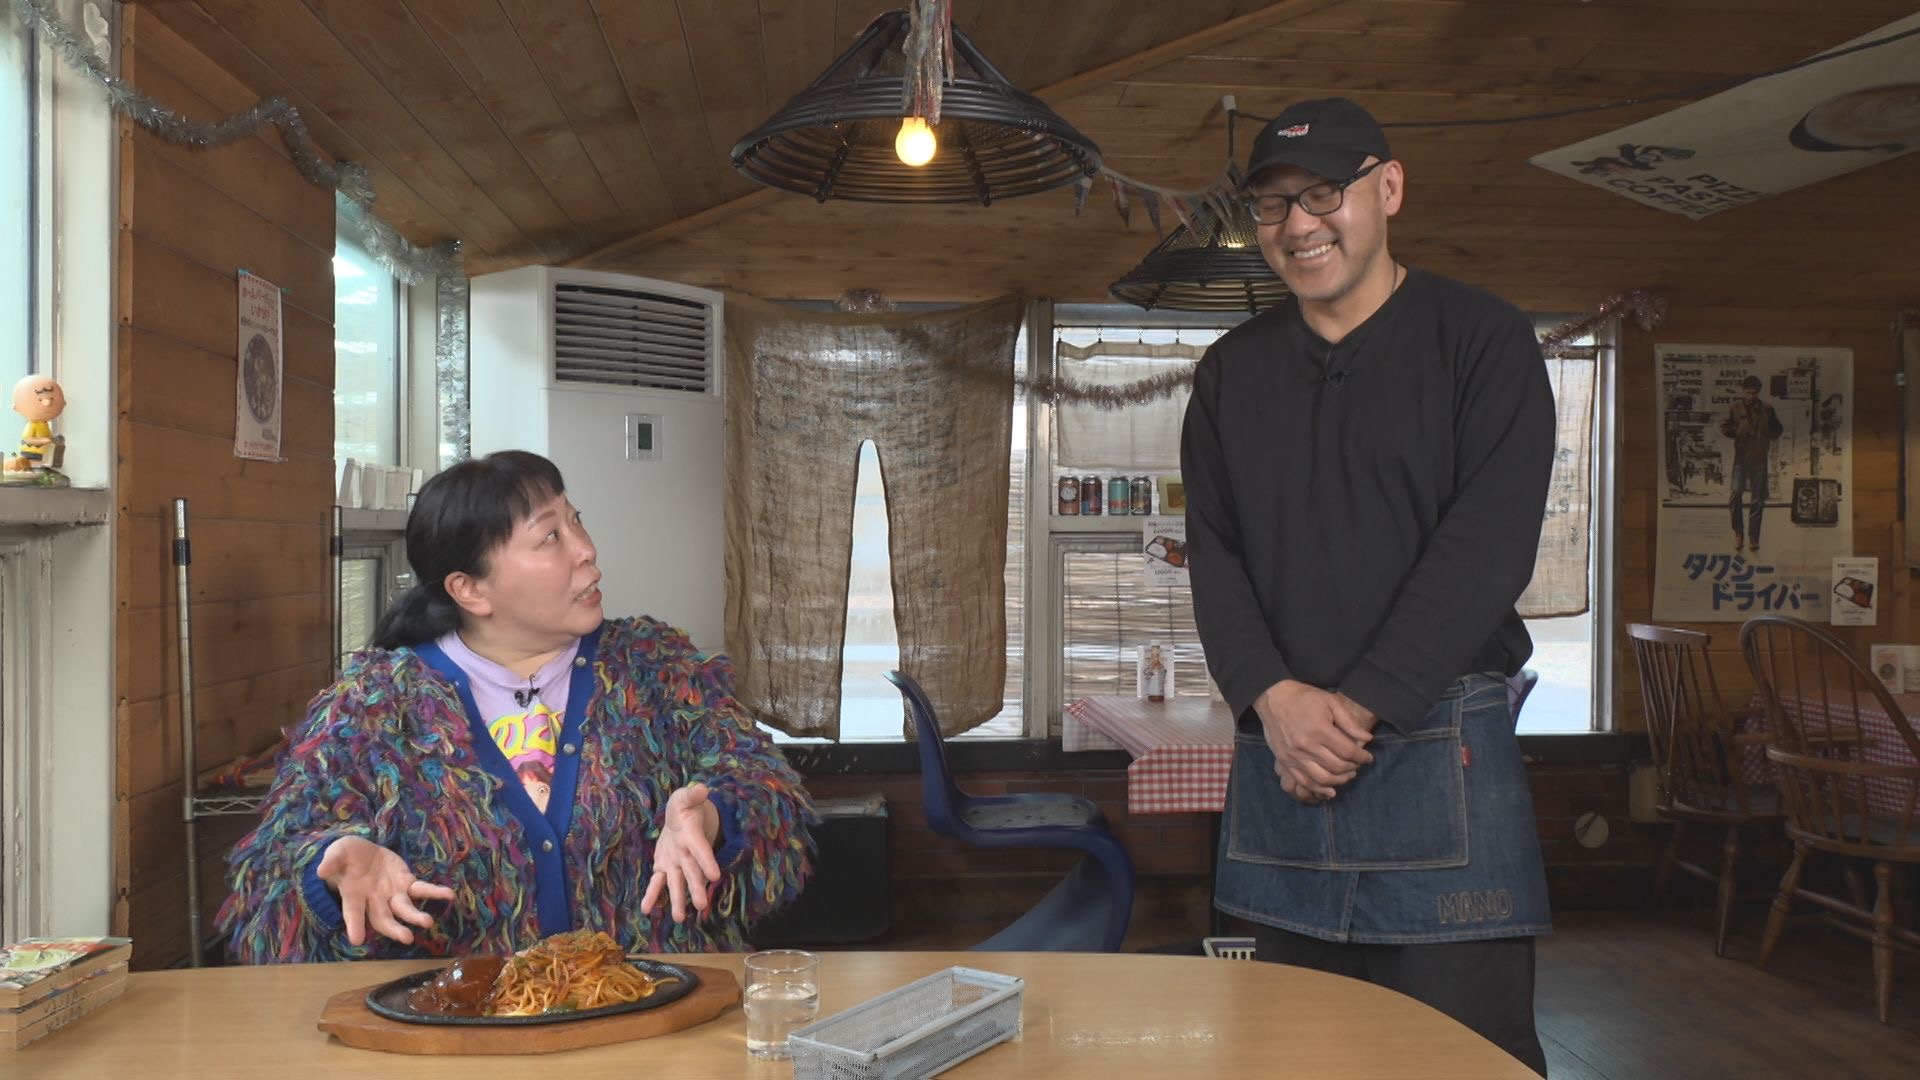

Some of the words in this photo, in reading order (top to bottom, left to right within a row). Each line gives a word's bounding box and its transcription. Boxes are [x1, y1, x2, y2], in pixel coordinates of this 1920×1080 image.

[1683, 553, 1774, 582] タクシー
[1712, 583, 1820, 611] ドライバー
[1437, 889, 1514, 924] MANO
